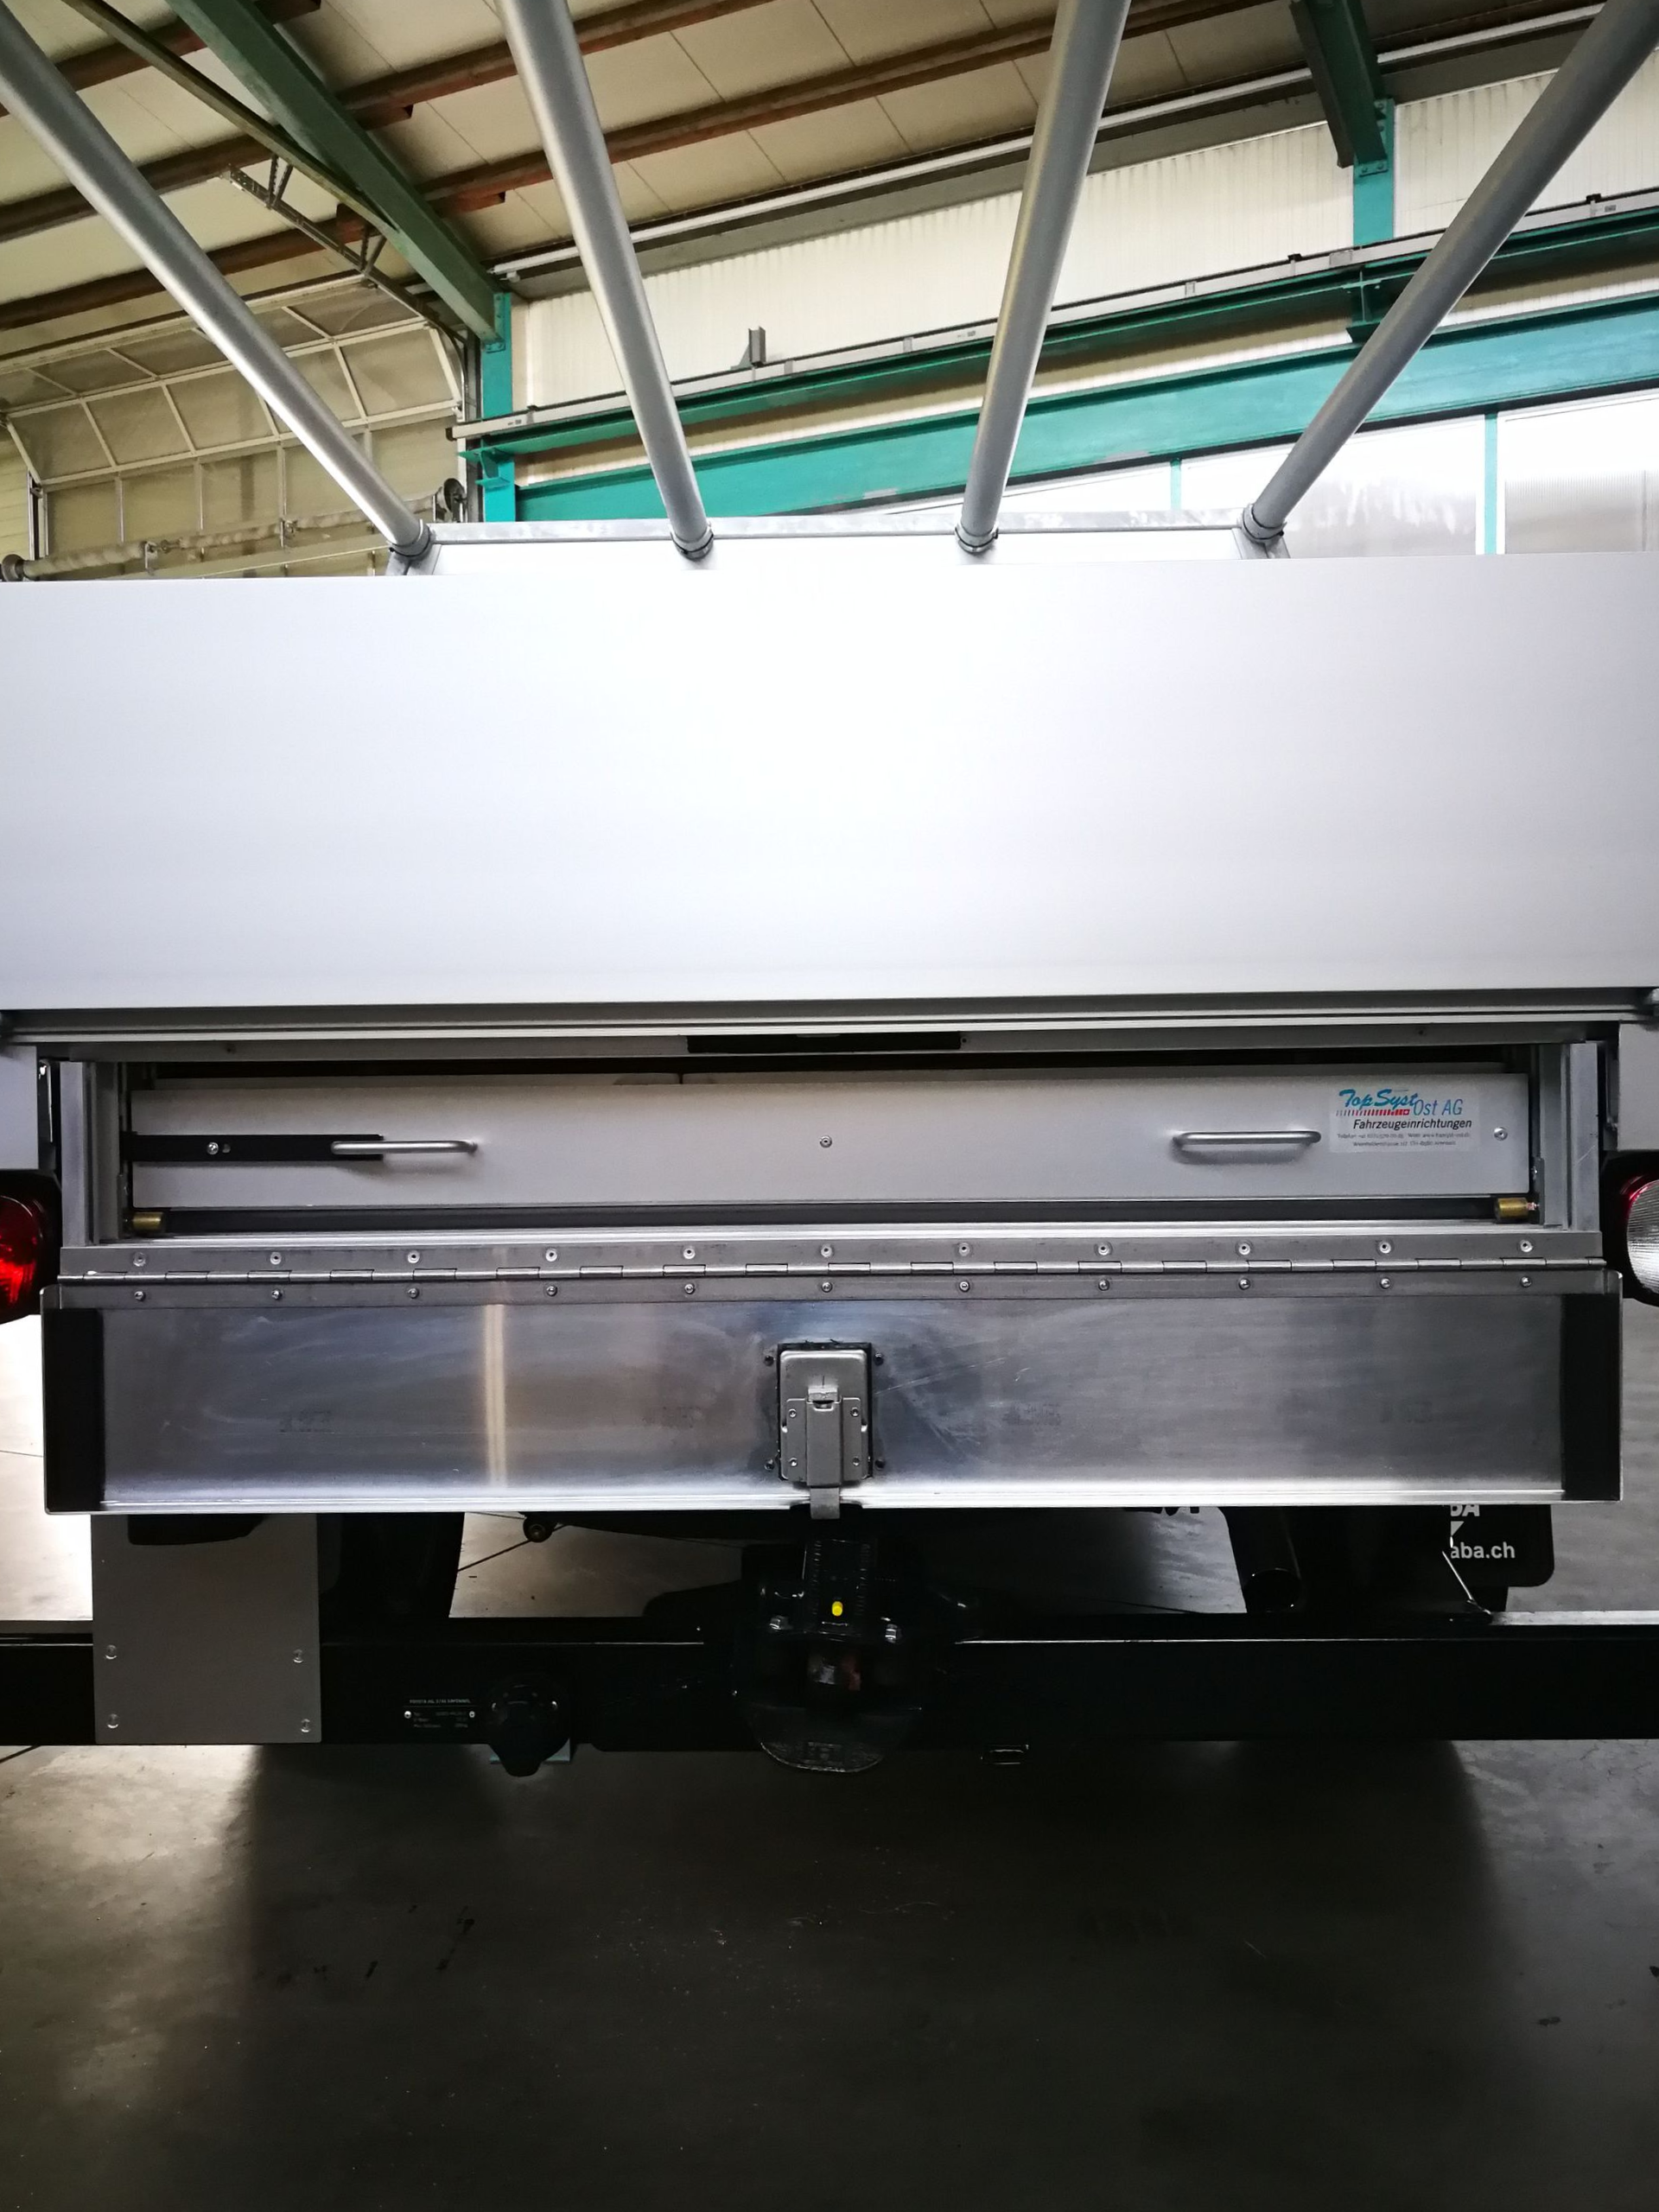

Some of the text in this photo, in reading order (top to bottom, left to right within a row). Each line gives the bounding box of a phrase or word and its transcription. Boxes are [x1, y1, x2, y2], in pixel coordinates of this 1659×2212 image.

[1414, 1099, 1438, 1116] Ost
[1441, 1098, 1463, 1116] AG
[1353, 1119, 1472, 1131] Fahrzeugeinrichtungen
